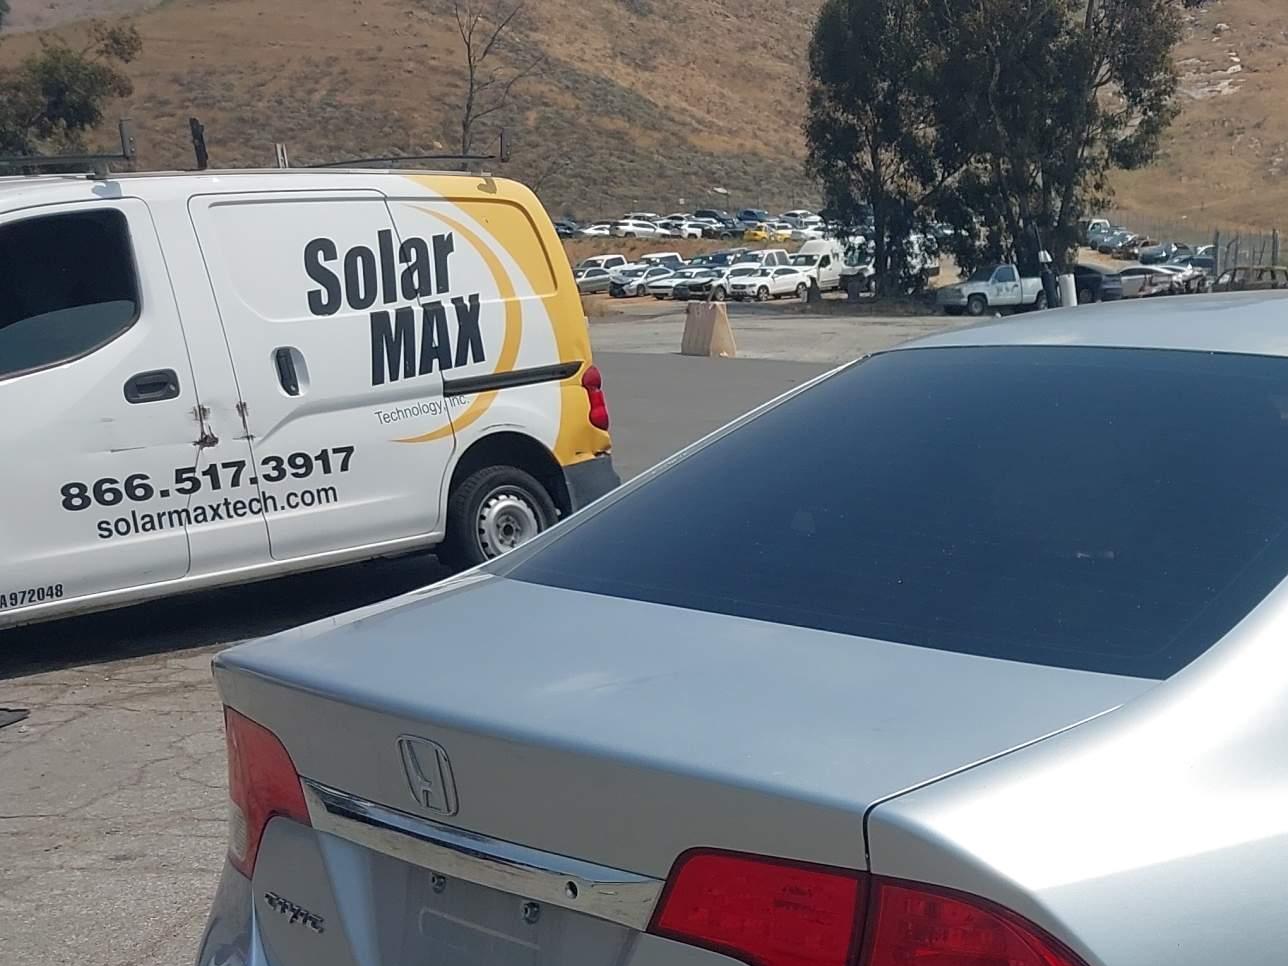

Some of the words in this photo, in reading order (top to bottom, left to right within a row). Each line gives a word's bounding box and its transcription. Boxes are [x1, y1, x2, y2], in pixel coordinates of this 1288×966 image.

[304, 229, 454, 316] Solar
[370, 293, 486, 386] MAX
[374, 400, 447, 424] Technology,
[60, 446, 355, 512] 866.517.3917
[97, 486, 338, 539] solarmaxtech.com
